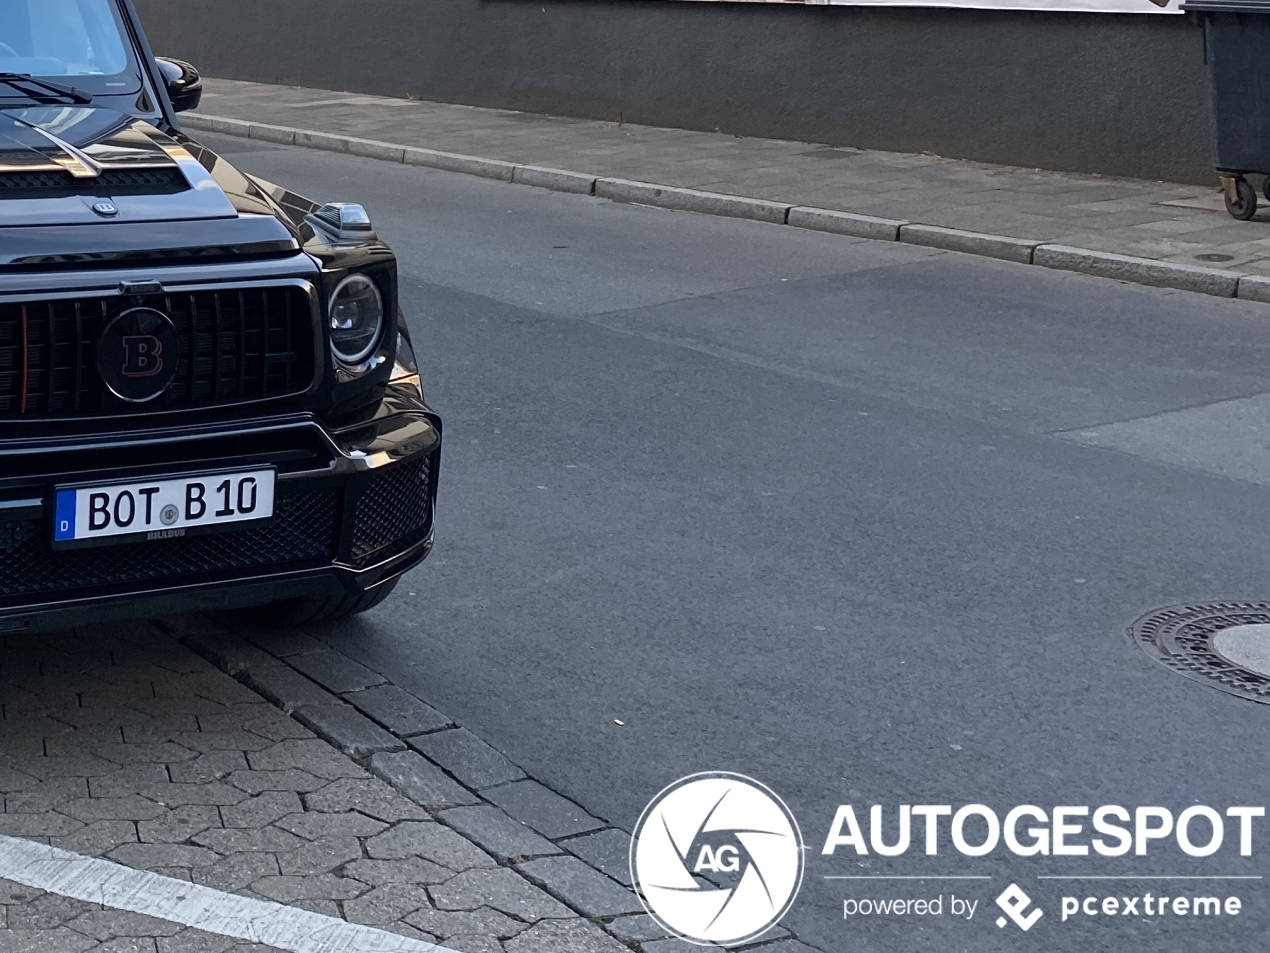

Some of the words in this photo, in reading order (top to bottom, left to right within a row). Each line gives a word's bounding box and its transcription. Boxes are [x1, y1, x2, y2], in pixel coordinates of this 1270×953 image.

[122, 335, 164, 377] B
[60, 520, 68, 532] D
[88, 486, 160, 531] BOT
[146, 528, 186, 541] BRABUS
